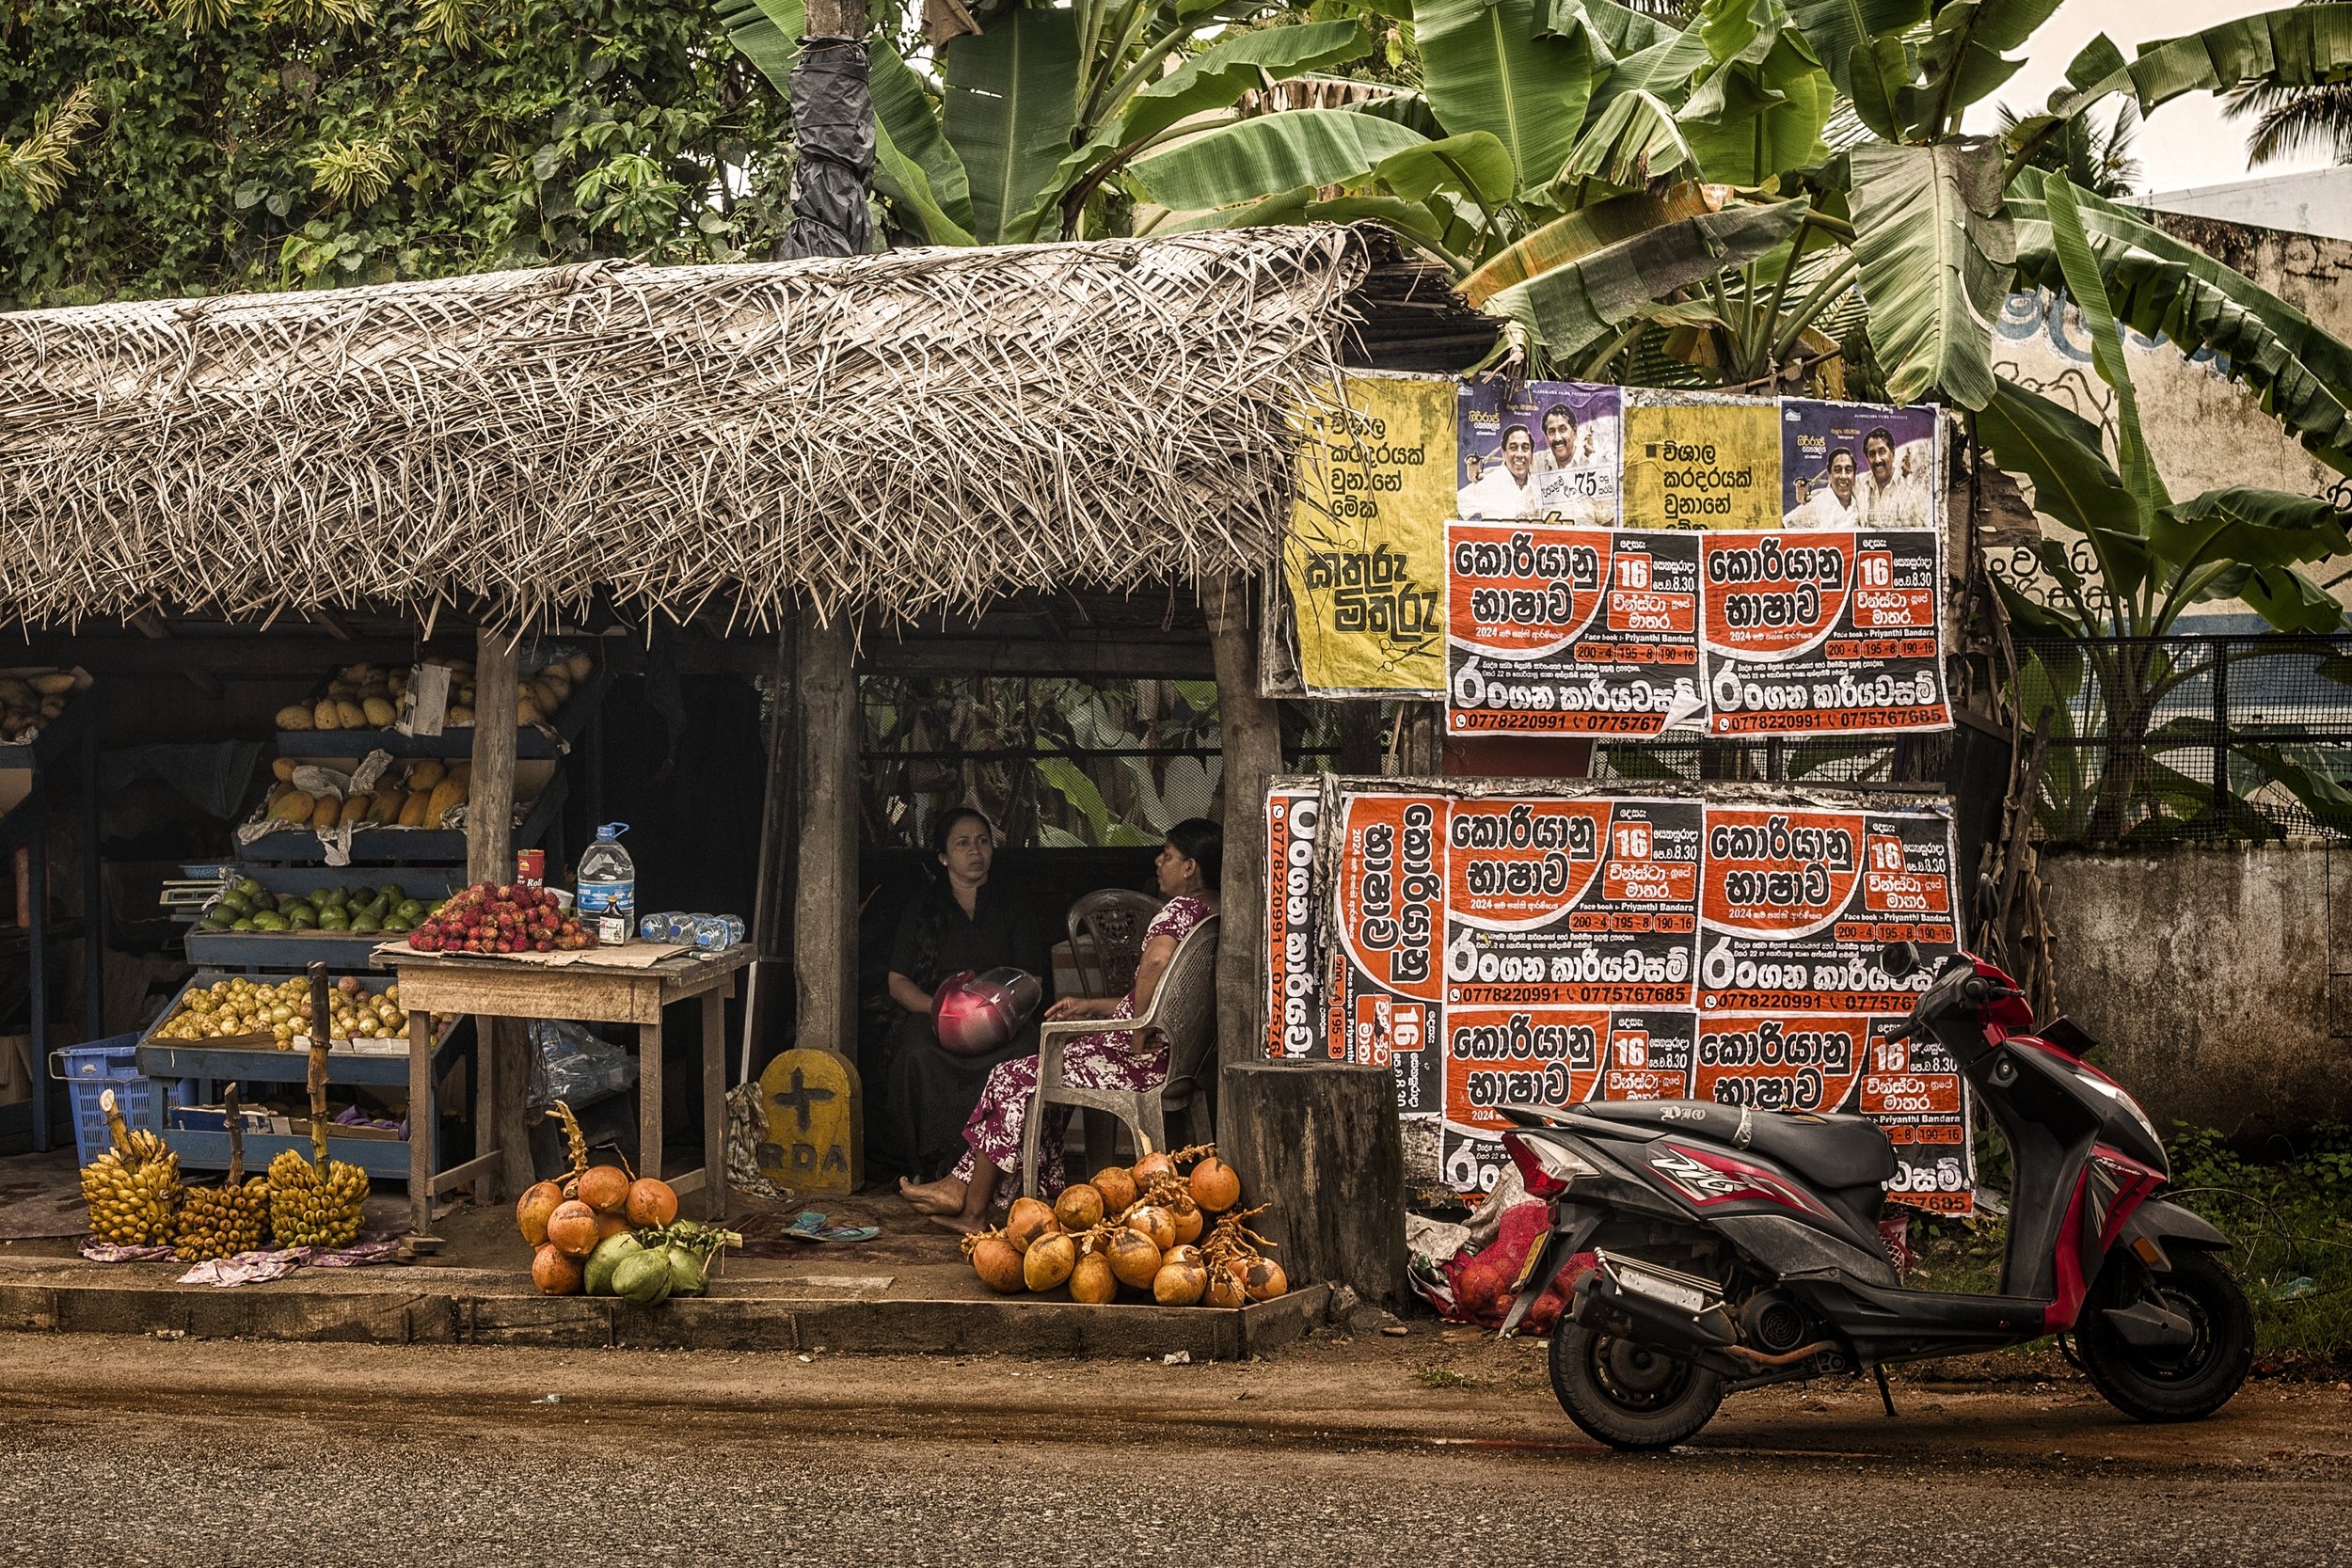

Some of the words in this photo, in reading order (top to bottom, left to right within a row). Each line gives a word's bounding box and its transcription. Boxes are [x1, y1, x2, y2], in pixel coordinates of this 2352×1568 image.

[1663, 440, 1716, 465] විශාල
[1574, 471, 1597, 497] 75
[1663, 466, 1753, 492] කරදරයක්
[1332, 495, 1378, 518] මේක
[1664, 493, 1731, 519] වුනානේ
[1304, 542, 1408, 594] කතුරු
[1454, 531, 1599, 591] කොරියානු
[1708, 535, 1844, 590] කොරියානු
[1859, 557, 1889, 586] 16
[1618, 559, 1647, 589] 16
[1333, 581, 1441, 643] මිතුරු
[1470, 583, 1573, 626] භාෂාව
[1724, 583, 1821, 626] භාෂාව
[1475, 626, 1498, 638] 2024
[1625, 634, 1661, 644] Priyanthi
[1661, 635, 1695, 643] Bandara
[1729, 631, 1751, 641] 2024
[1833, 630, 1847, 639] Face
[1869, 629, 1903, 640] Priyanthi
[1903, 628, 1935, 638] Bandara
[1577, 646, 1597, 657] 200
[1605, 648, 1612, 658] 4
[1620, 648, 1637, 658] 195
[1645, 649, 1653, 659] 8
[1660, 649, 1677, 660] 190
[1681, 648, 1694, 660] 16
[1828, 643, 1845, 655] 200
[1852, 642, 1859, 655] 4
[1866, 642, 1883, 654] 195
[1889, 642, 1896, 654] 8
[1903, 641, 1917, 653] 190
[1925, 641, 1933, 653] 16
[1468, 712, 1566, 729] 0778220991
[1731, 713, 1821, 732] 0778220991
[1840, 708, 1943, 727] 0775767685
[1352, 828, 1361, 856] 2024
[1451, 804, 1597, 862] කොරියානු
[1615, 828, 1647, 858] 16
[1709, 814, 1854, 874] කොරියානු
[1872, 841, 1901, 870] 16
[526, 879, 543, 888] Roll
[1272, 821, 1285, 944] 0778220991
[1467, 851, 1570, 896] භාෂාව
[1724, 863, 1831, 908] භාෂාව
[1361, 823, 1401, 951] භාෂාව
[1390, 804, 1441, 985] කොරියානු
[1470, 899, 1492, 911] 2024
[1580, 902, 1596, 911] Face
[1620, 901, 1658, 913] Priyanthi
[1660, 903, 1694, 912] Bandara
[1728, 909, 1752, 920] 2024
[1573, 916, 1591, 927] 200
[1600, 916, 1607, 927] 4
[1614, 916, 1633, 928] 195
[1643, 917, 1649, 928] 8
[1657, 917, 1673, 929] 190
[1681, 917, 1692, 929] 16
[1844, 913, 1860, 922] Face
[1861, 913, 1878, 922] book
[1883, 912, 1920, 924] Priyanthi
[1920, 914, 1951, 923] Bandara
[1837, 927, 1857, 938] 200
[1866, 927, 1873, 938] 4
[1880, 927, 1898, 939] 195
[1906, 928, 1913, 939] 8
[1920, 928, 1935, 939] 190
[1942, 929, 1951, 940] 16
[1346, 989, 1355, 1010] book
[1463, 987, 1560, 1003] 0778220991
[1581, 987, 1685, 1003] 0775767685
[1718, 993, 1821, 1008] 0778220991
[1845, 993, 1918, 1010] 077576
[1272, 972, 1284, 1054] 077576
[1332, 1011, 1343, 1036] 195
[1393, 1007, 1420, 1046] 16
[1332, 1045, 1343, 1054] 8
[1453, 1013, 1597, 1072] කොරියානු
[1615, 1037, 1645, 1067] 16
[1699, 1022, 1852, 1075] කොරියානු
[1873, 1043, 1905, 1071] 16
[1467, 1060, 1571, 1108] භාෂාව
[1713, 1066, 1823, 1111] භාෂාව
[1471, 1110, 1494, 1120] 2024
[1880, 1115, 1920, 1125] Priyanthi
[1921, 1115, 1961, 1124] Bandara
[1904, 1130, 1912, 1140] 8
[1920, 1130, 1938, 1140] 190
[1947, 1130, 1960, 1140] 16
[757, 1143, 849, 1175] RDA
